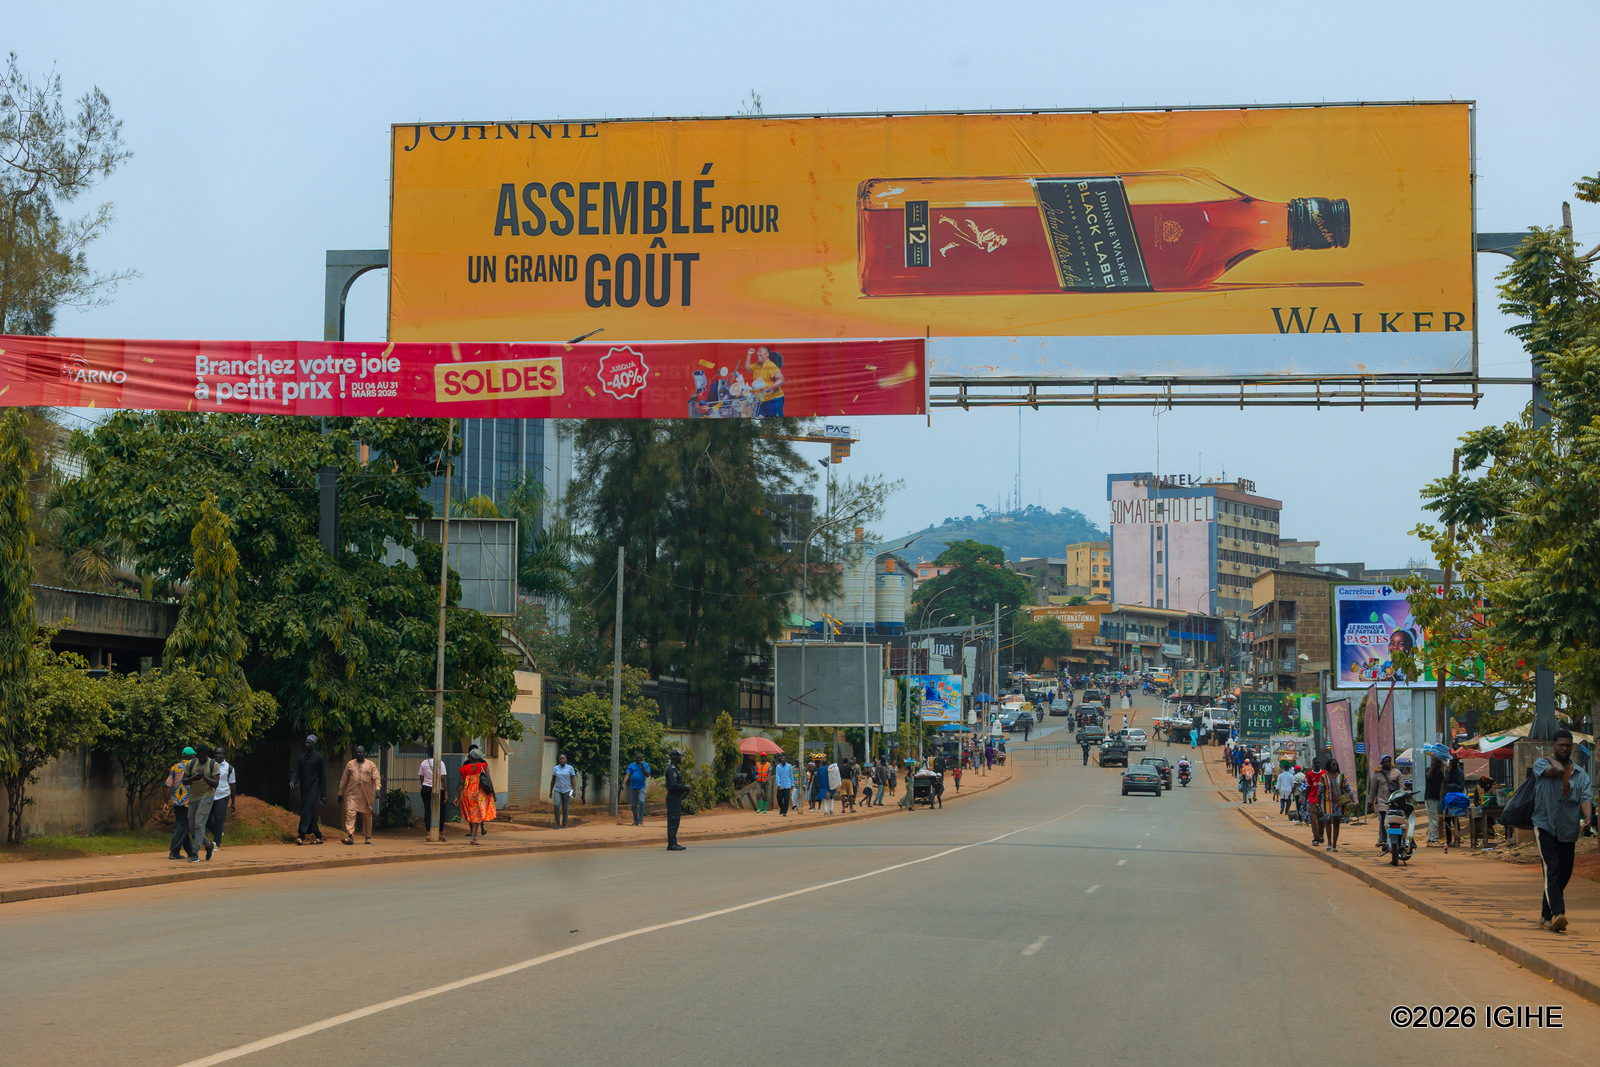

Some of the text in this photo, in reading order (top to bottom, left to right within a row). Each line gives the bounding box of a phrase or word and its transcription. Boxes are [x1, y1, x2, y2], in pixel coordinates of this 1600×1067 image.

[494, 162, 779, 236] ASSEMBLÉ POUR
[1077, 181, 1101, 237] BLACK
[1095, 190, 1118, 237] JOHNNIE
[909, 224, 927, 244] 12
[468, 237, 700, 308] UN GRAND GOÛT
[73, 369, 127, 384] ARNO
[195, 351, 400, 379] Branchez votre joie
[607, 368, 642, 389] -40%
[194, 374, 346, 406] à petit prix !
[351, 381, 398, 390] DU 04 AU 31
[351, 389, 397, 398] MARS 2026
[443, 365, 557, 396] SOLDES
[825, 424, 850, 434] PAC
[1110, 497, 1214, 524] SOMATEL HOTEL
[1260, 704, 1273, 712] ROI
